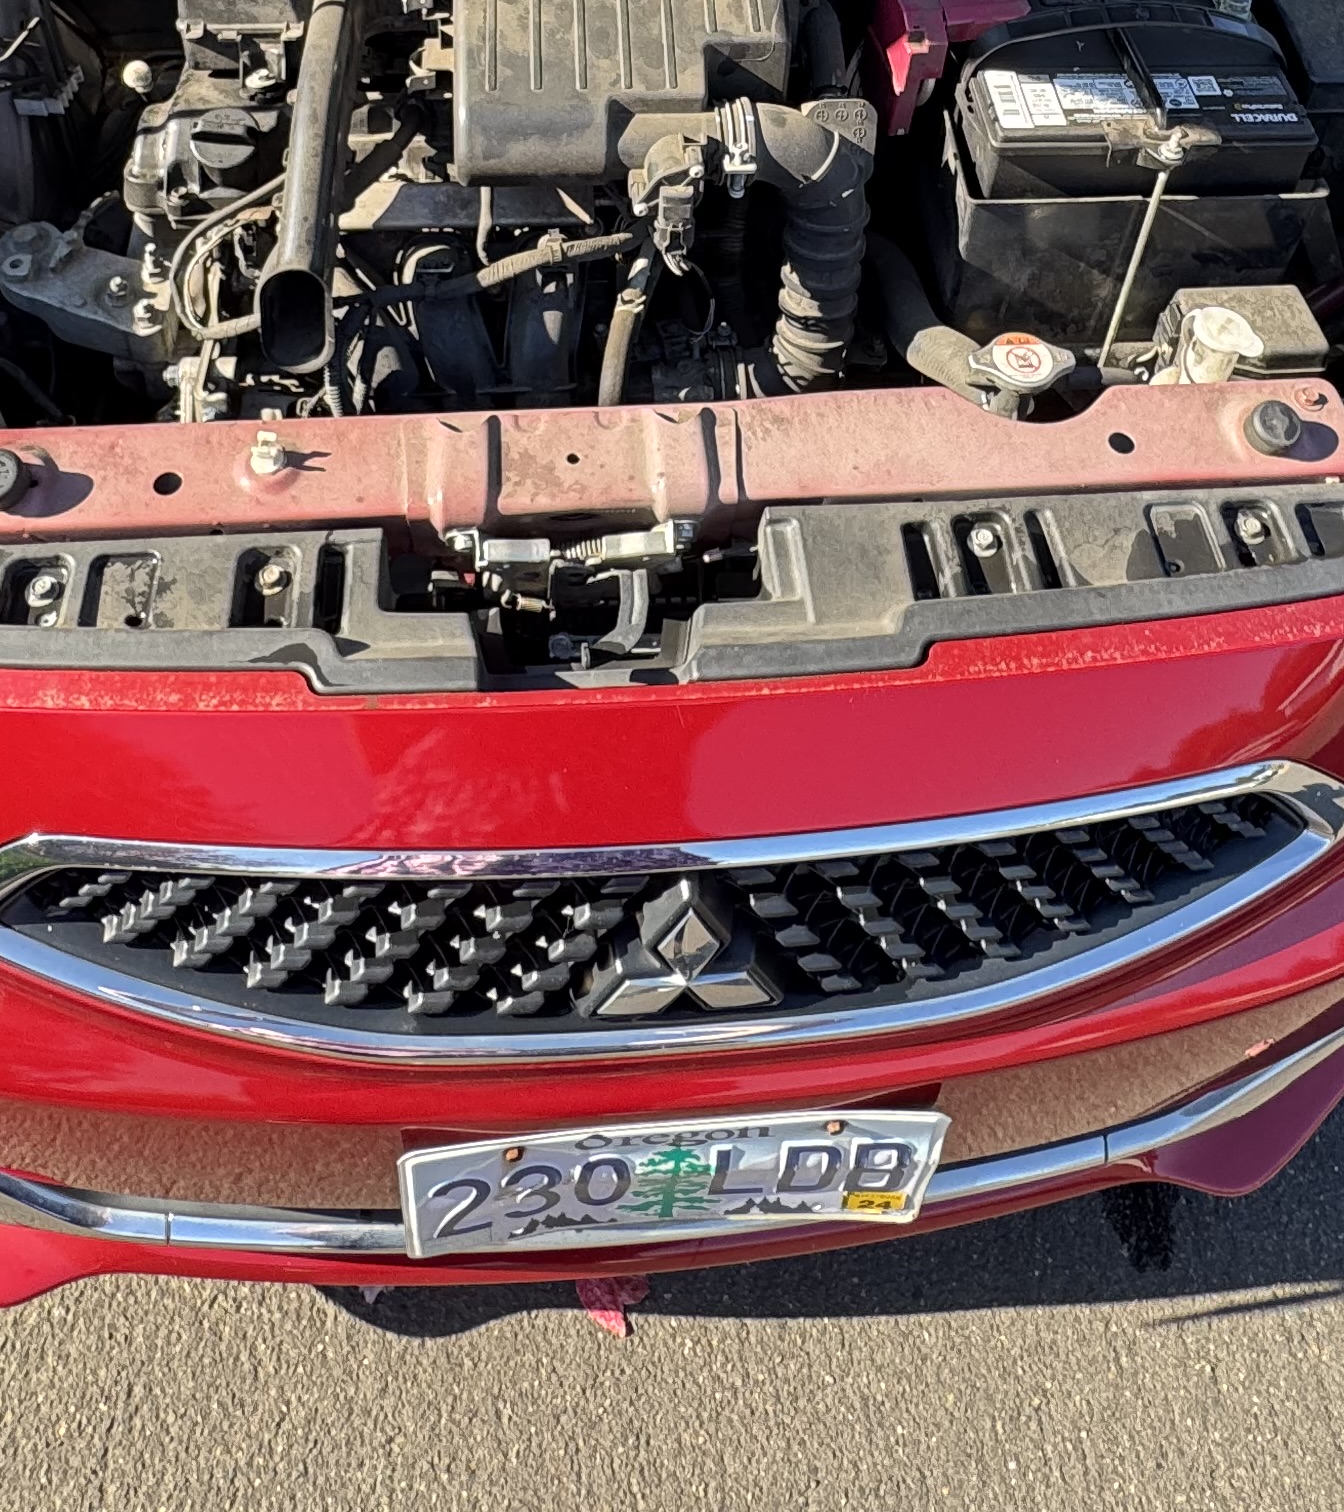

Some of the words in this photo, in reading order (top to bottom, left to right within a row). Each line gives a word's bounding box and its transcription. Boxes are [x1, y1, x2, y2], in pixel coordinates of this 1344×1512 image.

[1230, 112, 1299, 123] DURACELL
[574, 1125, 776, 1151] Oregon
[431, 1157, 633, 1238] 230
[857, 1199, 892, 1209] 24
